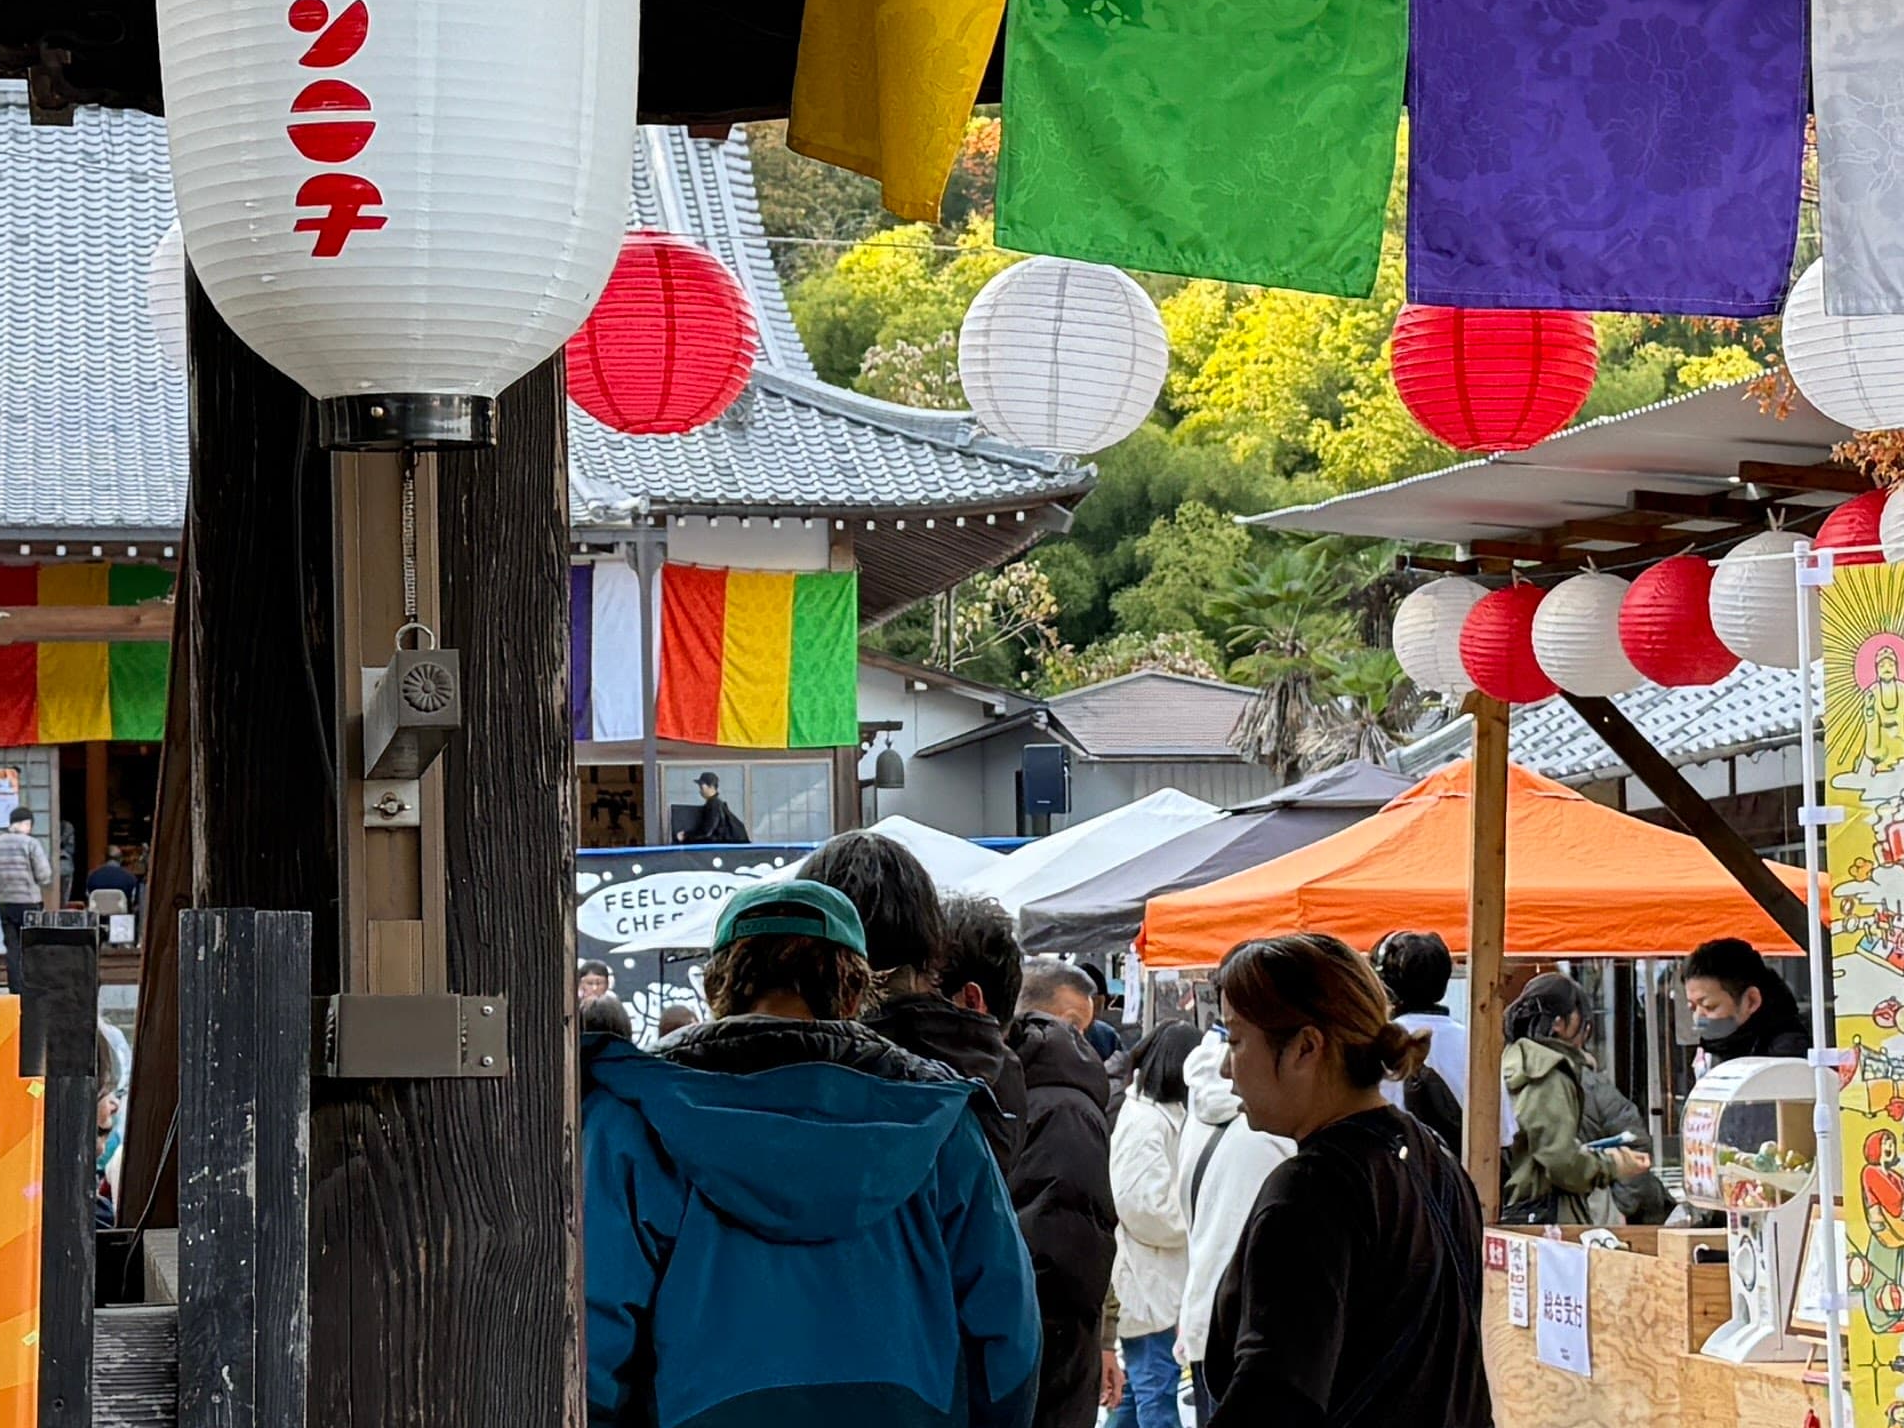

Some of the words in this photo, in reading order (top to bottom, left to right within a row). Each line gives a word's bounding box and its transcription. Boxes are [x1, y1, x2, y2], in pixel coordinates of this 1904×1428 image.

[604, 889, 666, 913] FEEL
[616, 913, 684, 935] CHE
[1543, 1290, 1583, 1329] 総合受付
